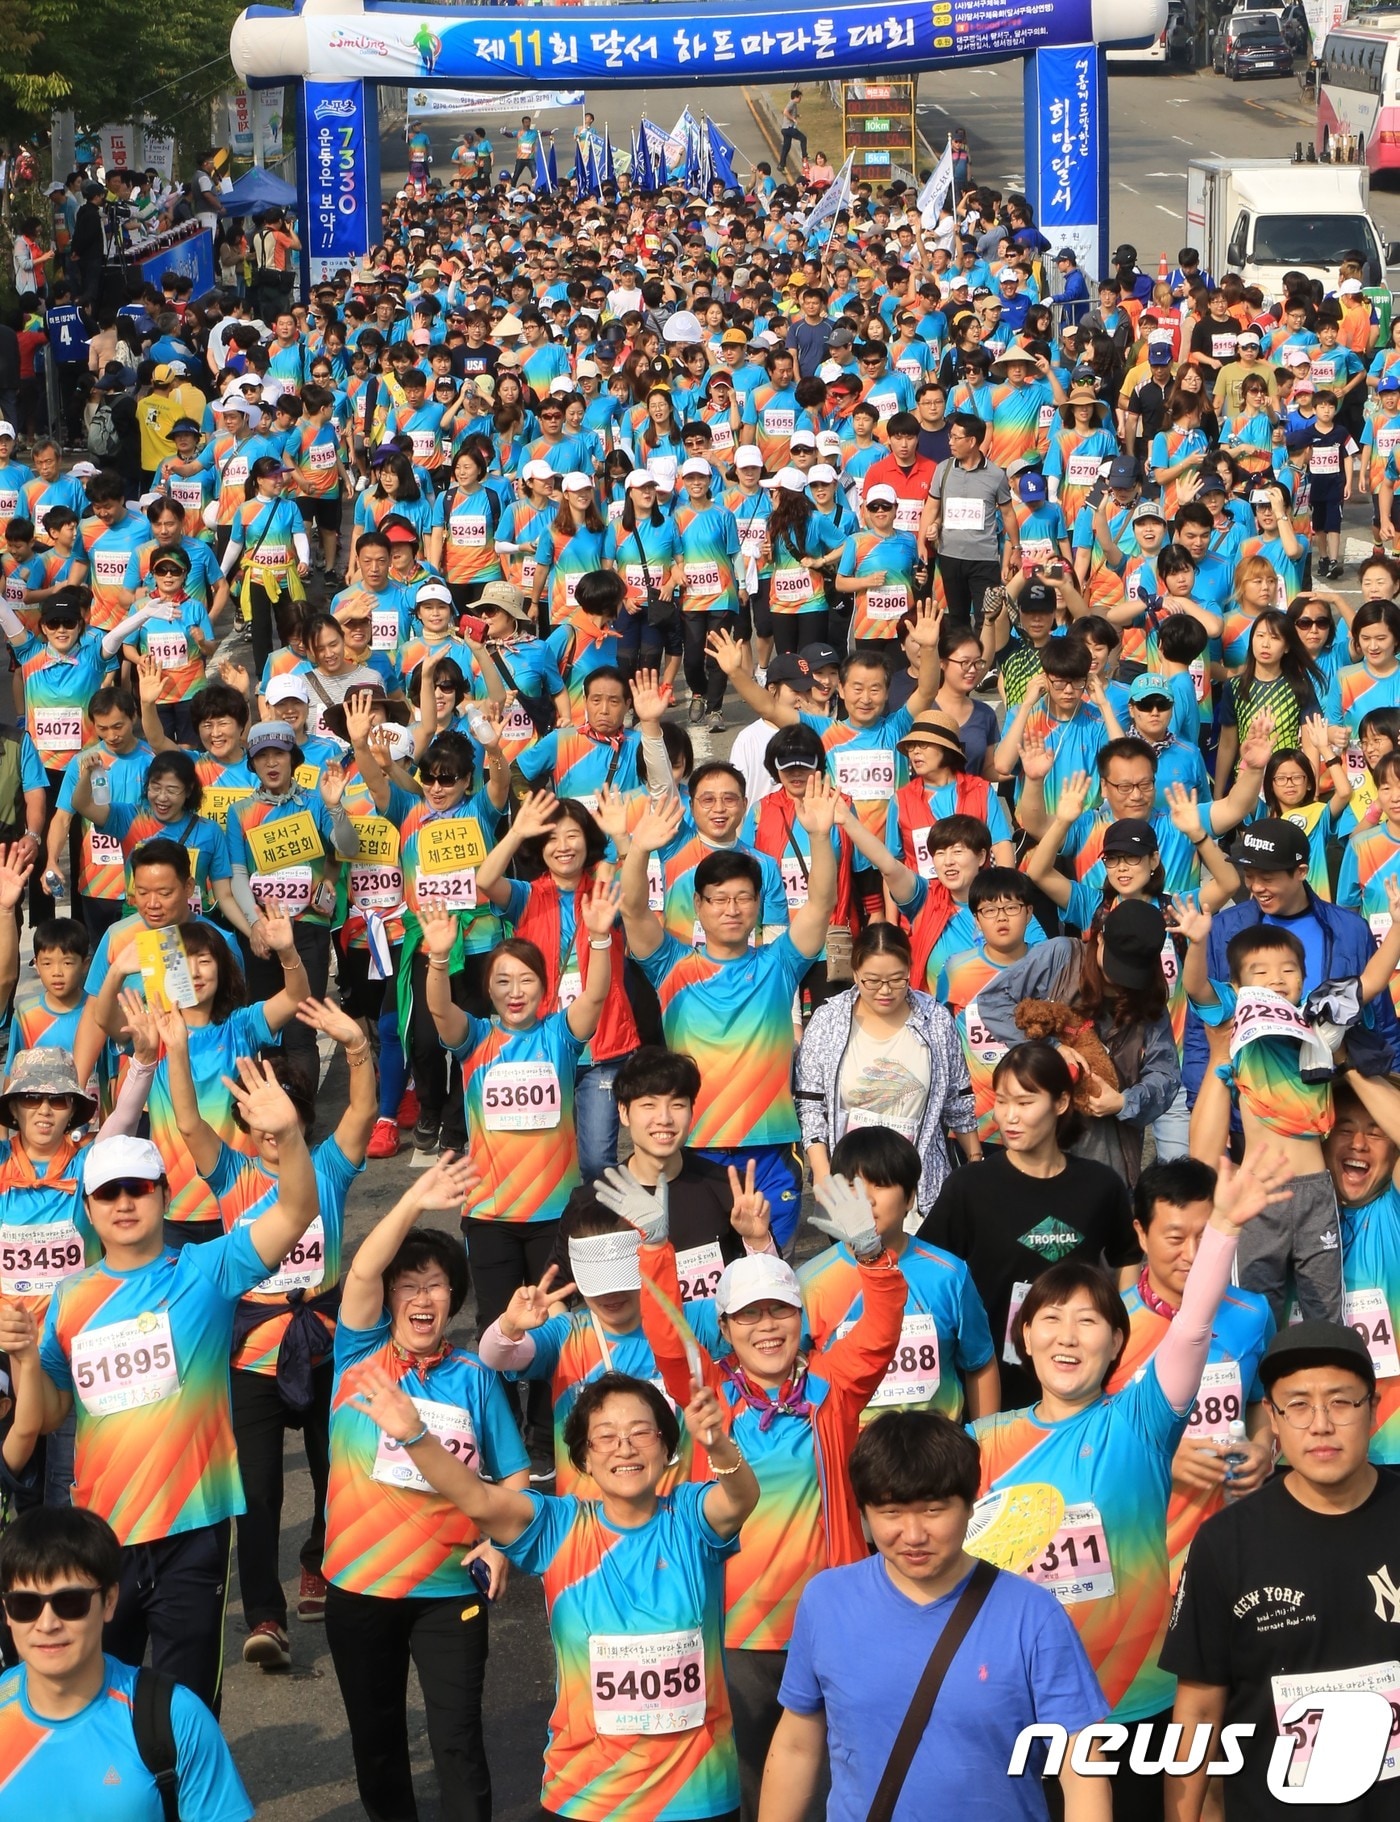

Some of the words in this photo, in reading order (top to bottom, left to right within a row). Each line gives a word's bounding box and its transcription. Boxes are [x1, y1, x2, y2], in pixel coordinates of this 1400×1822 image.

[329, 32, 388, 56] Smiling
[474, 29, 578, 67] 제11회
[590, 29, 657, 67] 달서
[848, 17, 915, 50] 대회
[1075, 60, 1090, 101] 새롭게
[866, 88, 890, 98] 하프코스
[316, 99, 356, 113] 스포츠
[867, 121, 889, 131] 10km
[1079, 102, 1090, 157] 도약하는
[318, 128, 334, 187] 운동은
[867, 154, 888, 163] 5km
[338, 127, 357, 215] 7330
[320, 194, 337, 248] 보약!!
[60, 325, 72, 345] 4
[466, 360, 483, 371] USA
[1381, 377, 1388, 386] T
[875, 401, 897, 413] 3099
[765, 419, 793, 429] 51055
[412, 440, 433, 448] 3718
[310, 451, 334, 463] 53153
[1310, 455, 1338, 465] 53762
[224, 466, 246, 477] 3042
[1028, 481, 1036, 492] LA
[171, 491, 199, 501] 53047
[896, 510, 922, 521] 2721
[947, 509, 981, 519] 52726
[452, 525, 486, 536] 52494
[739, 529, 765, 539] 2802
[254, 554, 285, 564] 52844
[686, 572, 718, 585] 52805
[776, 577, 810, 591] 52800
[1030, 585, 1045, 599] S
[868, 597, 905, 608] 52806
[150, 644, 186, 656] 51614
[1138, 677, 1168, 689] PINK
[37, 722, 80, 735] 54072
[839, 767, 893, 783] 52069
[263, 823, 301, 843] 달서구
[431, 827, 468, 843] 달서구
[263, 836, 314, 863] 체조협회
[359, 839, 391, 857] 조협회
[428, 842, 479, 864] 체조협회
[351, 872, 401, 890] 52309
[252, 882, 309, 899] 52323
[418, 879, 472, 897] 52321
[486, 1084, 555, 1107] 53601
[1028, 1232, 1078, 1245] TROPICAL
[2, 1244, 81, 1271] 53459
[274, 1275, 311, 1288] 대구은행
[77, 1342, 170, 1389] 51895
[883, 1385, 925, 1398] 대구은행
[1233, 1590, 1260, 1619] NEW
[1263, 1586, 1305, 1606] YORK
[596, 1662, 701, 1701] 54058
[1280, 1687, 1304, 1698] 제11회
[615, 1713, 651, 1731] 서거달
